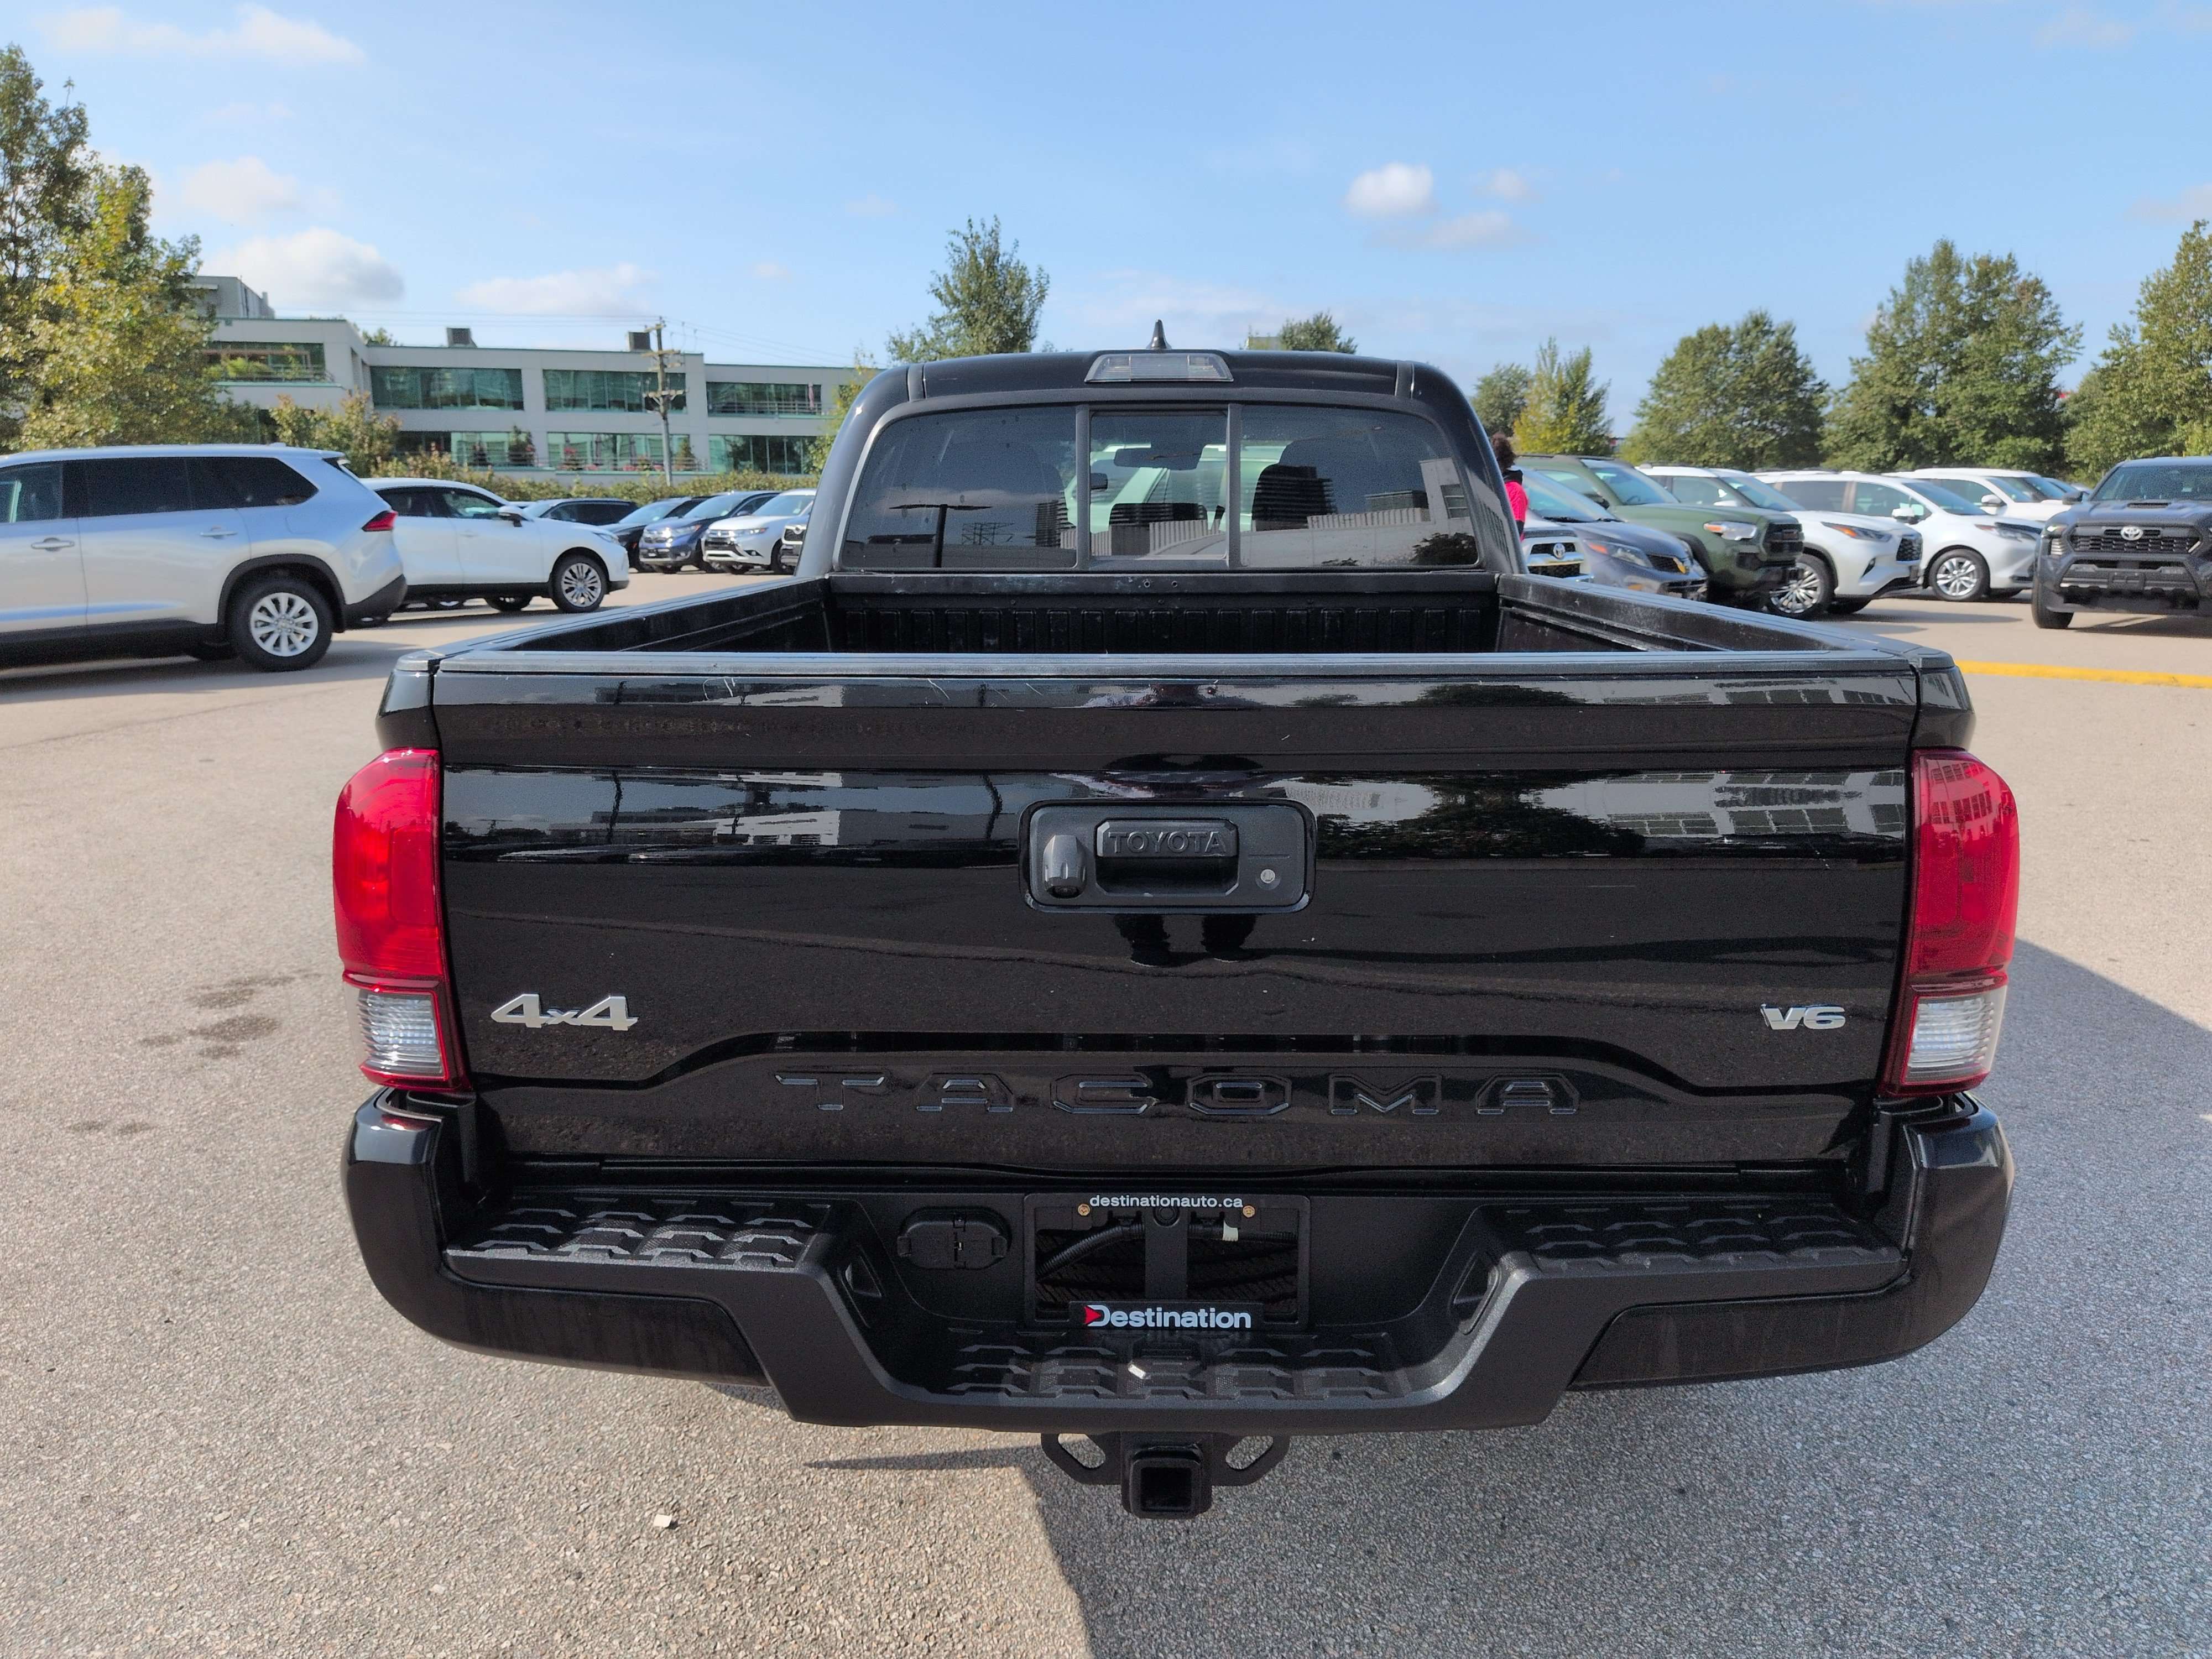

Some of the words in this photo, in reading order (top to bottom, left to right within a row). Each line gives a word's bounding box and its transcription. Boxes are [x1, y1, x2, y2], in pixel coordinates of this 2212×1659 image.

[1108, 831, 1227, 854] TOYOTA
[491, 994, 639, 1031] 4x4
[1761, 1004, 1846, 1030] V6
[775, 1068, 1579, 1115] TACOMA
[1089, 1195, 1244, 1208] destinationauto.ca
[1084, 1305, 1251, 1328] Destination
